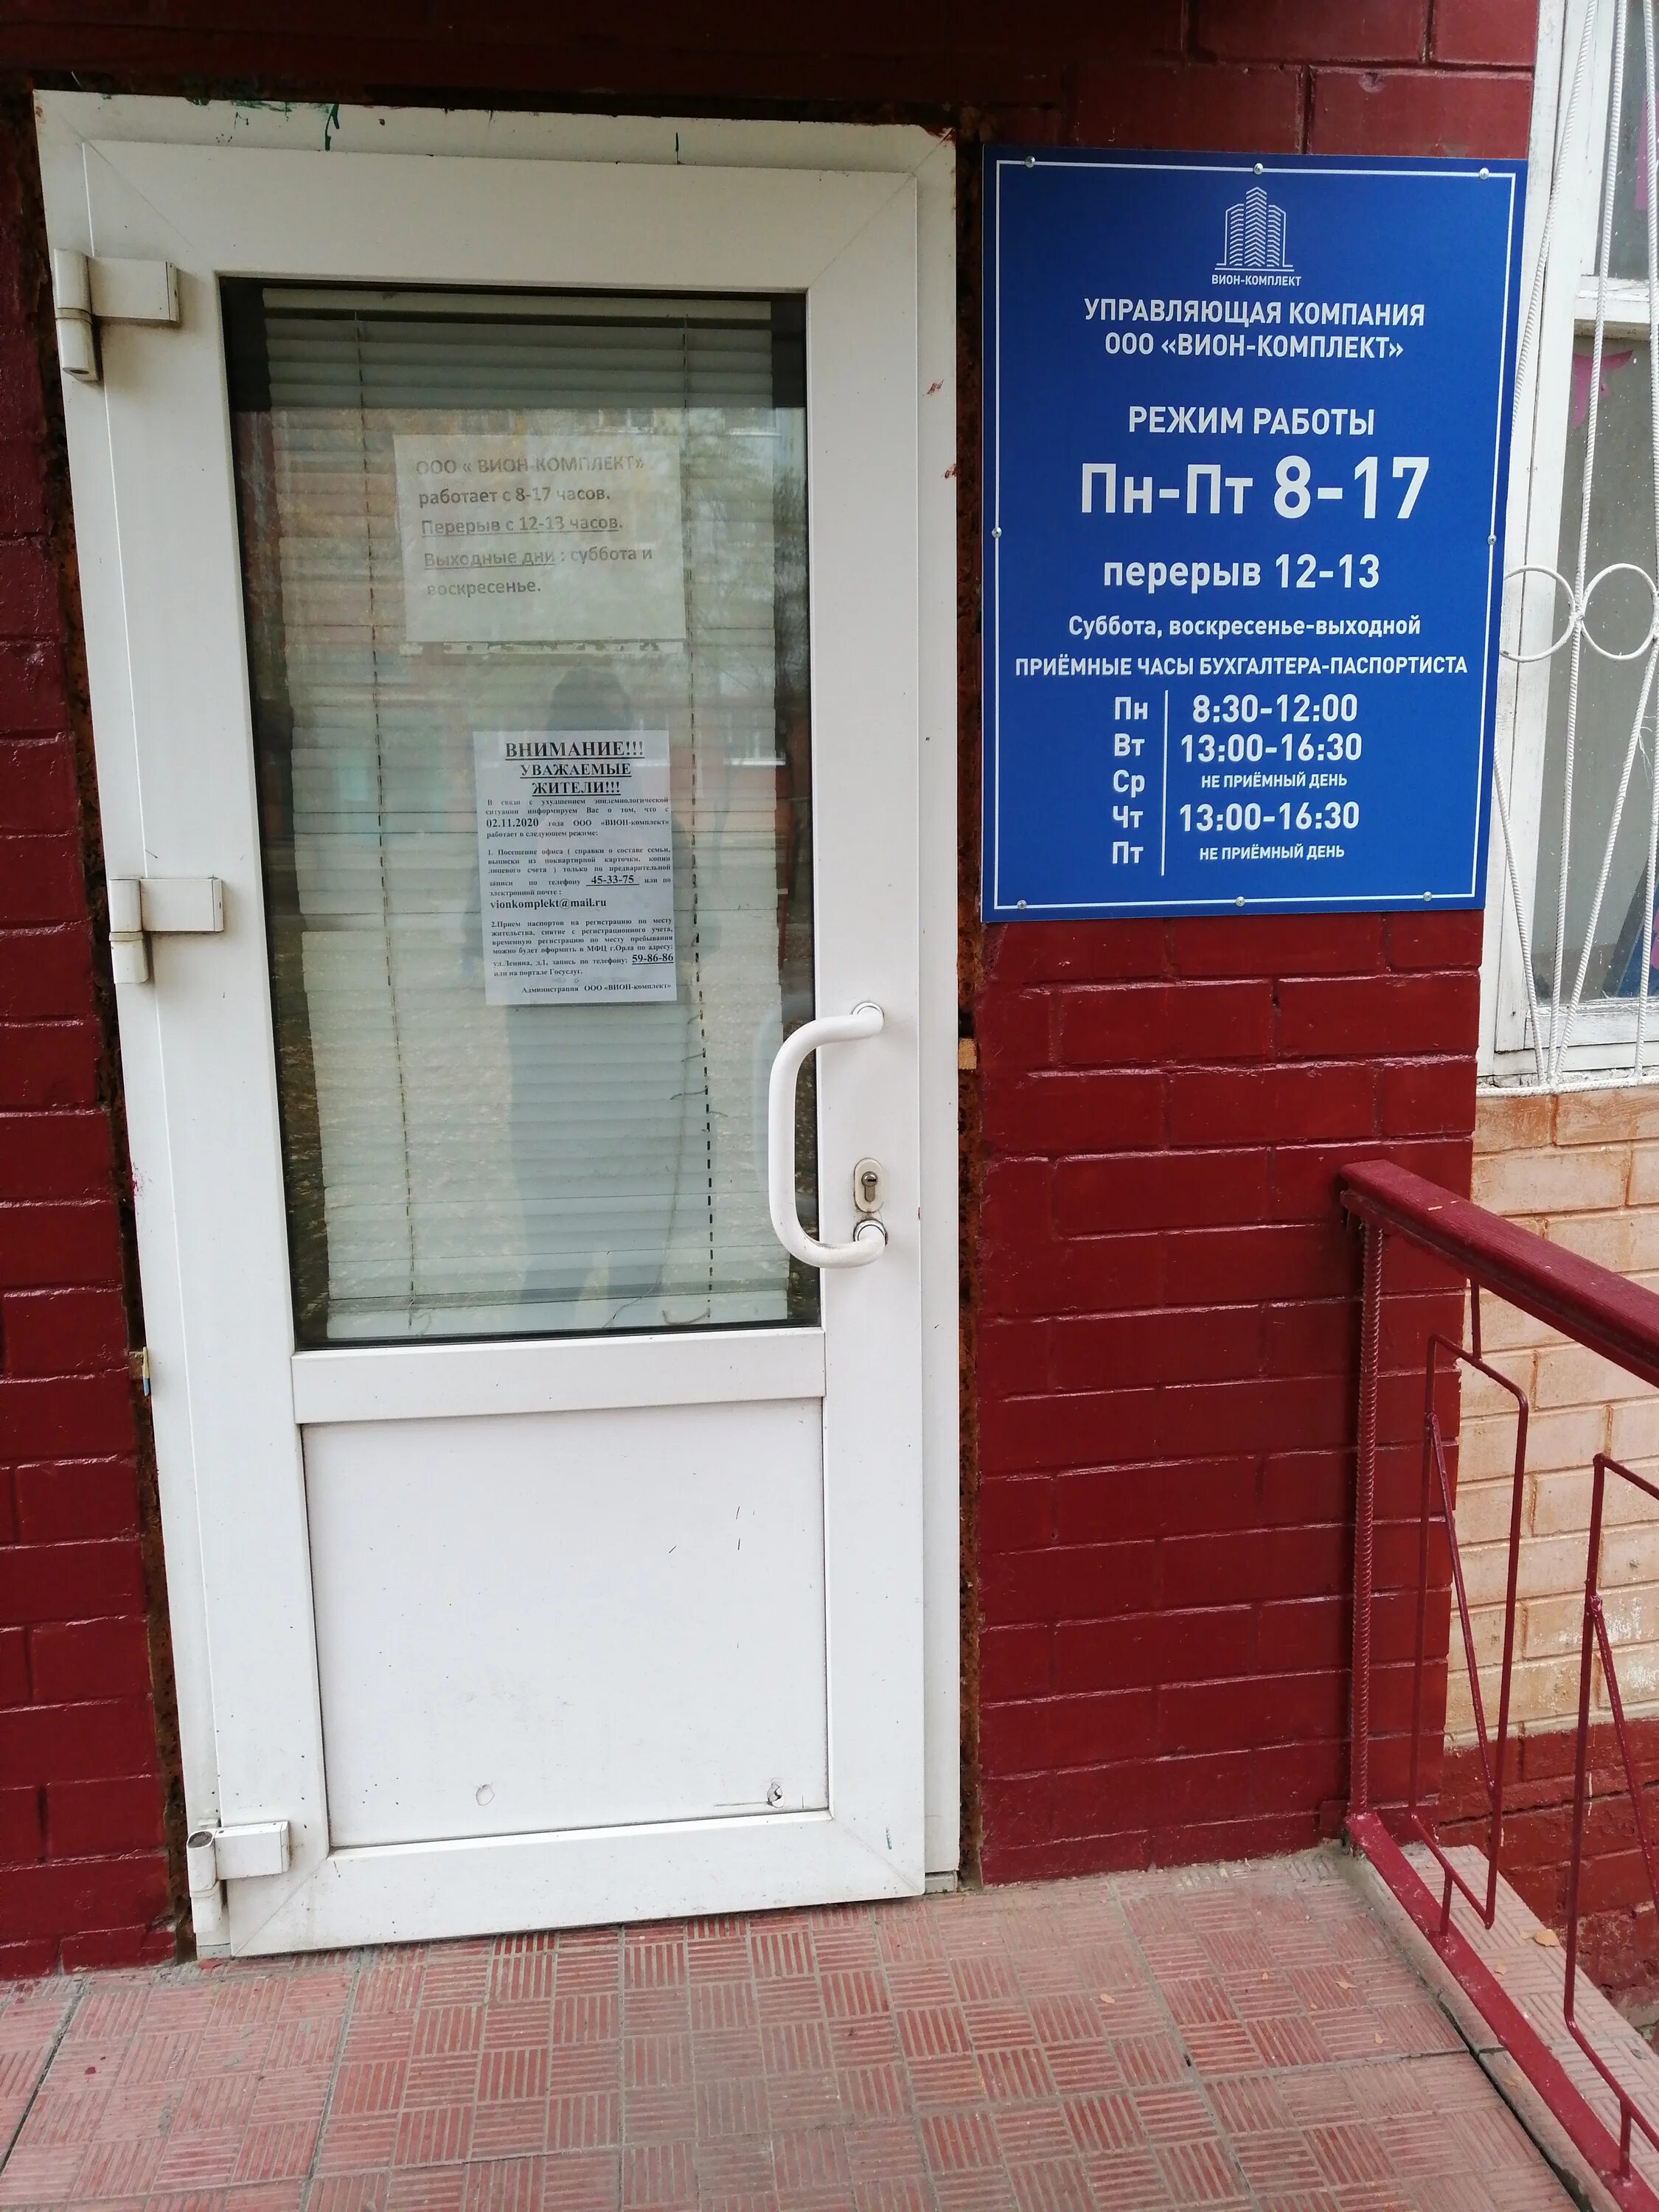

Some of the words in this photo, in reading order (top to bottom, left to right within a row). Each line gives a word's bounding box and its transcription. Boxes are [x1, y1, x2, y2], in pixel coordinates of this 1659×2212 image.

[1211, 274, 1301, 286] ВИОН-КОМПЛЕКТ
[1084, 298, 1282, 327] УПРАВЛЯЮЩАЯ
[1288, 302, 1425, 326] КОМПАНИЯ
[1161, 333, 1403, 359] «ВИОН-КОМПЛЕКТ»
[1129, 408, 1244, 434] РЕЖИМ
[1253, 408, 1374, 435] РАБОТЫ
[419, 490, 497, 507] работает
[503, 492, 510, 501] с
[515, 487, 551, 501] 8-17
[557, 490, 610, 501] часов.
[1081, 465, 1253, 514] Пн-Пт
[1274, 456, 1430, 520] 8-17
[422, 520, 500, 536] Перерыв
[507, 521, 513, 532] с
[570, 519, 623, 531] часов.
[425, 551, 516, 567] Выходные
[522, 553, 554, 565] дни
[570, 547, 637, 563] суббота
[643, 549, 652, 560] и
[1103, 560, 1261, 594] перерыв
[1275, 554, 1380, 588] 12-13
[428, 580, 540, 597] воскресенье.
[1069, 614, 1163, 637] Суббота,
[1169, 613, 1421, 637] воскресенье-выходной
[1015, 651, 1132, 675] ПРИЁМНЫЕ
[1137, 657, 1194, 674] ЧАСЫ
[1200, 655, 1467, 675] БУХГАЛТЕРА-ПАСПОРТИСТА
[1114, 697, 1148, 720] Пн
[1193, 695, 1357, 722] 8:30-12:00
[505, 742, 644, 758] ВНИМАНИЕ!!!
[1114, 733, 1144, 757] Вт
[1181, 733, 1362, 761] 13:00-16:30
[521, 764, 631, 777] УВАЖАЕМЫЕ
[532, 782, 620, 794] ЖИТЕЛИ!!!
[1113, 770, 1146, 799] Ср
[1201, 774, 1220, 788] НЕ
[1223, 770, 1306, 788] ПРИЁМНЫЙ
[1310, 774, 1347, 790] ДЕНЬ
[487, 818, 538, 827] 02.11.2020
[1113, 806, 1144, 829] Чт
[1180, 801, 1358, 830] 13:00-16:30
[1112, 842, 1144, 864] Пт
[1200, 846, 1218, 860] НЕ
[1222, 841, 1303, 860] ПРИЁМНЫЙ
[1307, 844, 1344, 860] ДЕНЬ
[609, 864, 671, 872] предварительной
[591, 875, 634, 884] 45-33-75
[490, 899, 606, 910] vionkomplekt@mail.ru
[630, 935, 672, 944] пребывания
[632, 954, 673, 963] 59-86-86
[549, 968, 582, 976] Госуслуг.
